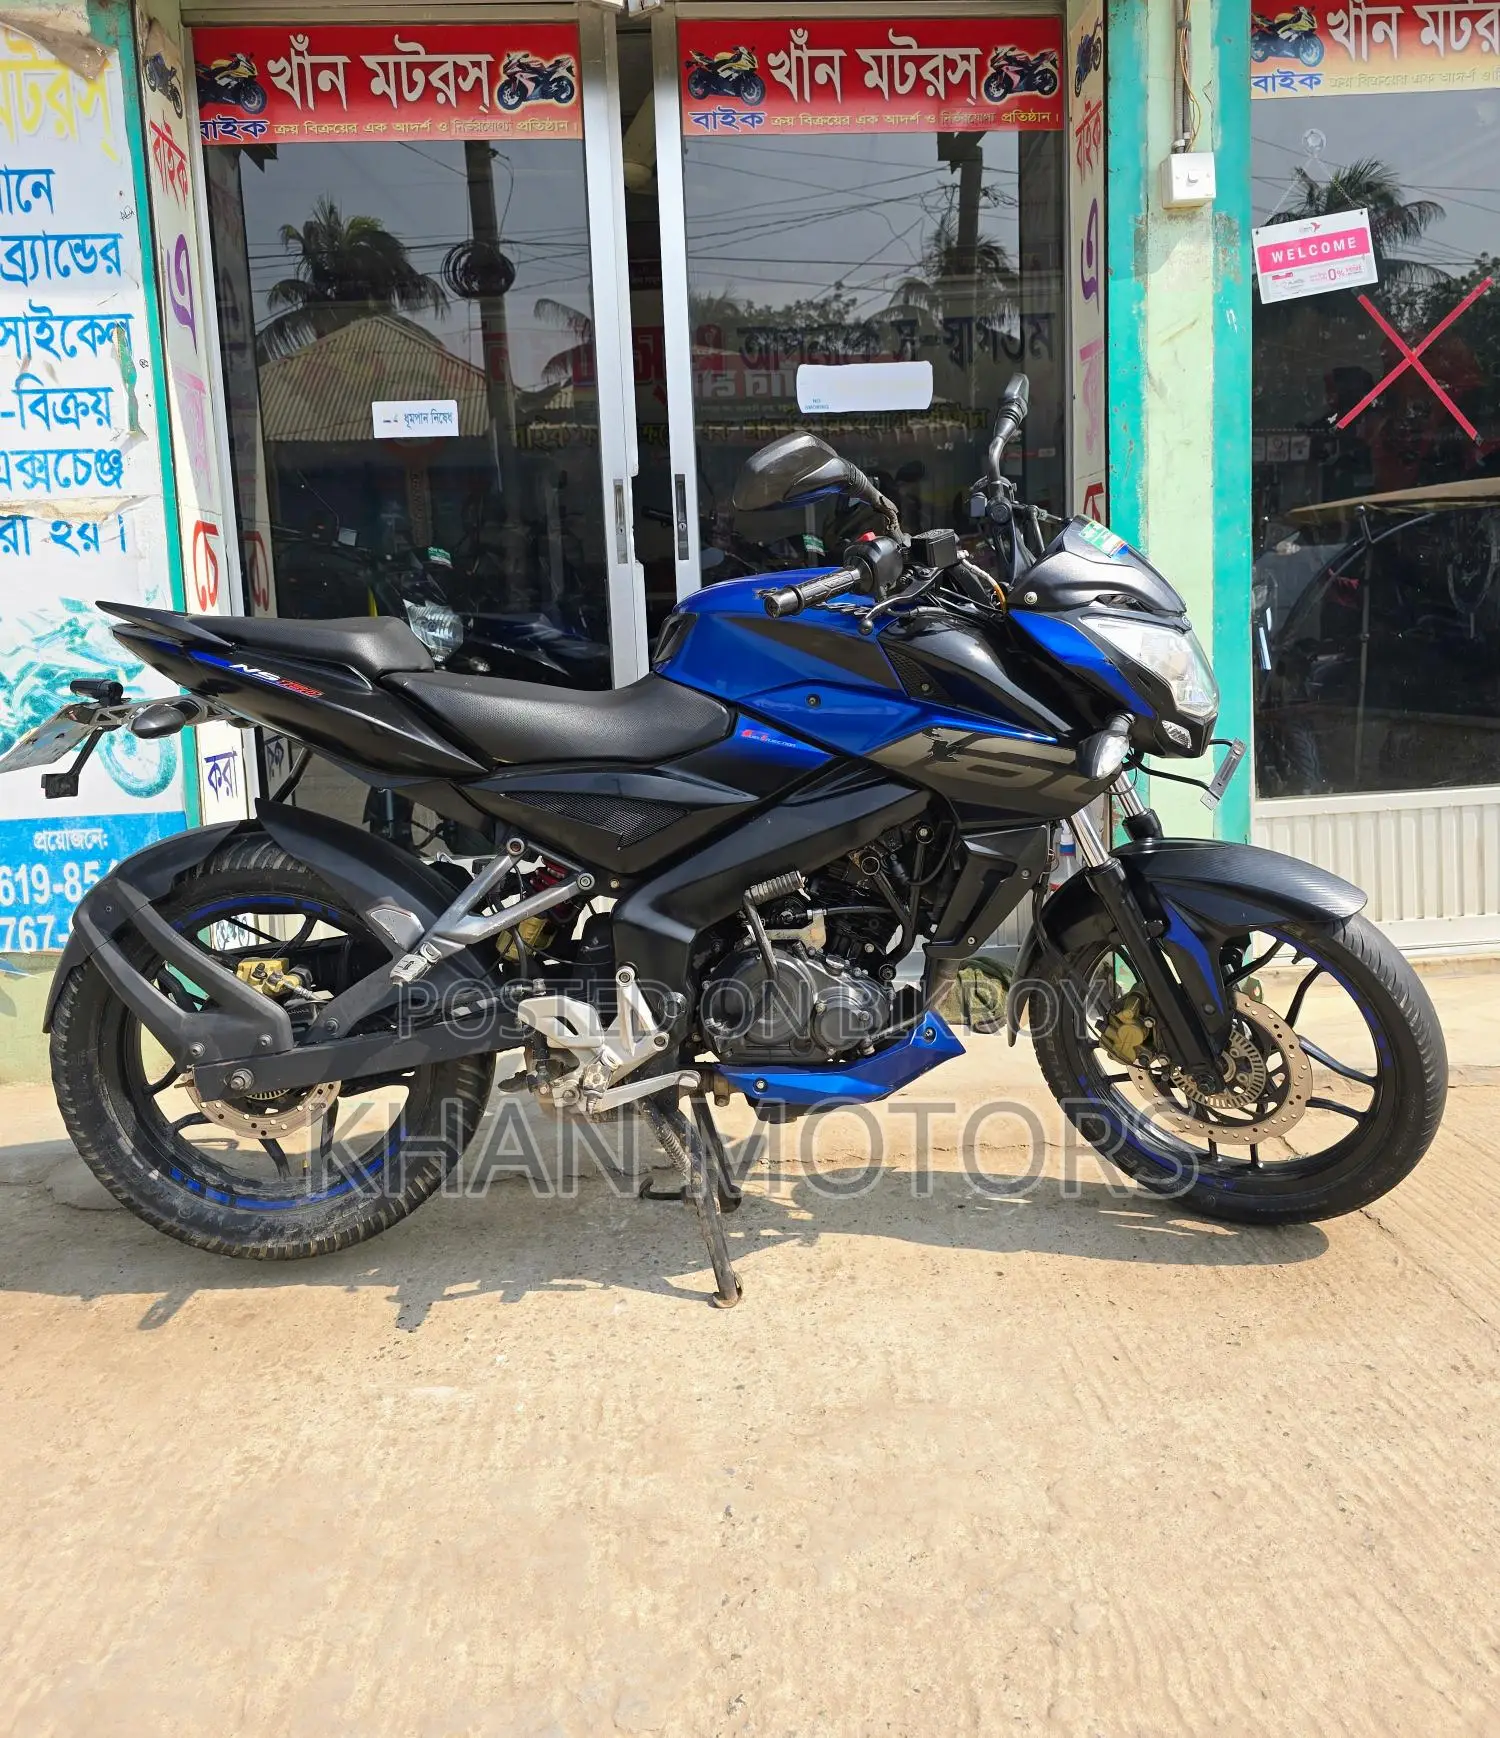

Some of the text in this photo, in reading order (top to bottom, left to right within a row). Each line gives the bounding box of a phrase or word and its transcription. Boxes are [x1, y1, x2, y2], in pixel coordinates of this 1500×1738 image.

[1326, 0, 1404, 62] খান
[267, 33, 496, 114] খাঁন মটরস্
[767, 28, 983, 107] খাঁন মটরস্
[1252, 69, 1323, 94] বাইক
[200, 114, 270, 142] বাইক
[688, 106, 767, 132] বাইক
[1271, 237, 1357, 264] WELCOME
[0, 860, 120, 907] 619-85
[0, 914, 76, 953] 767-
